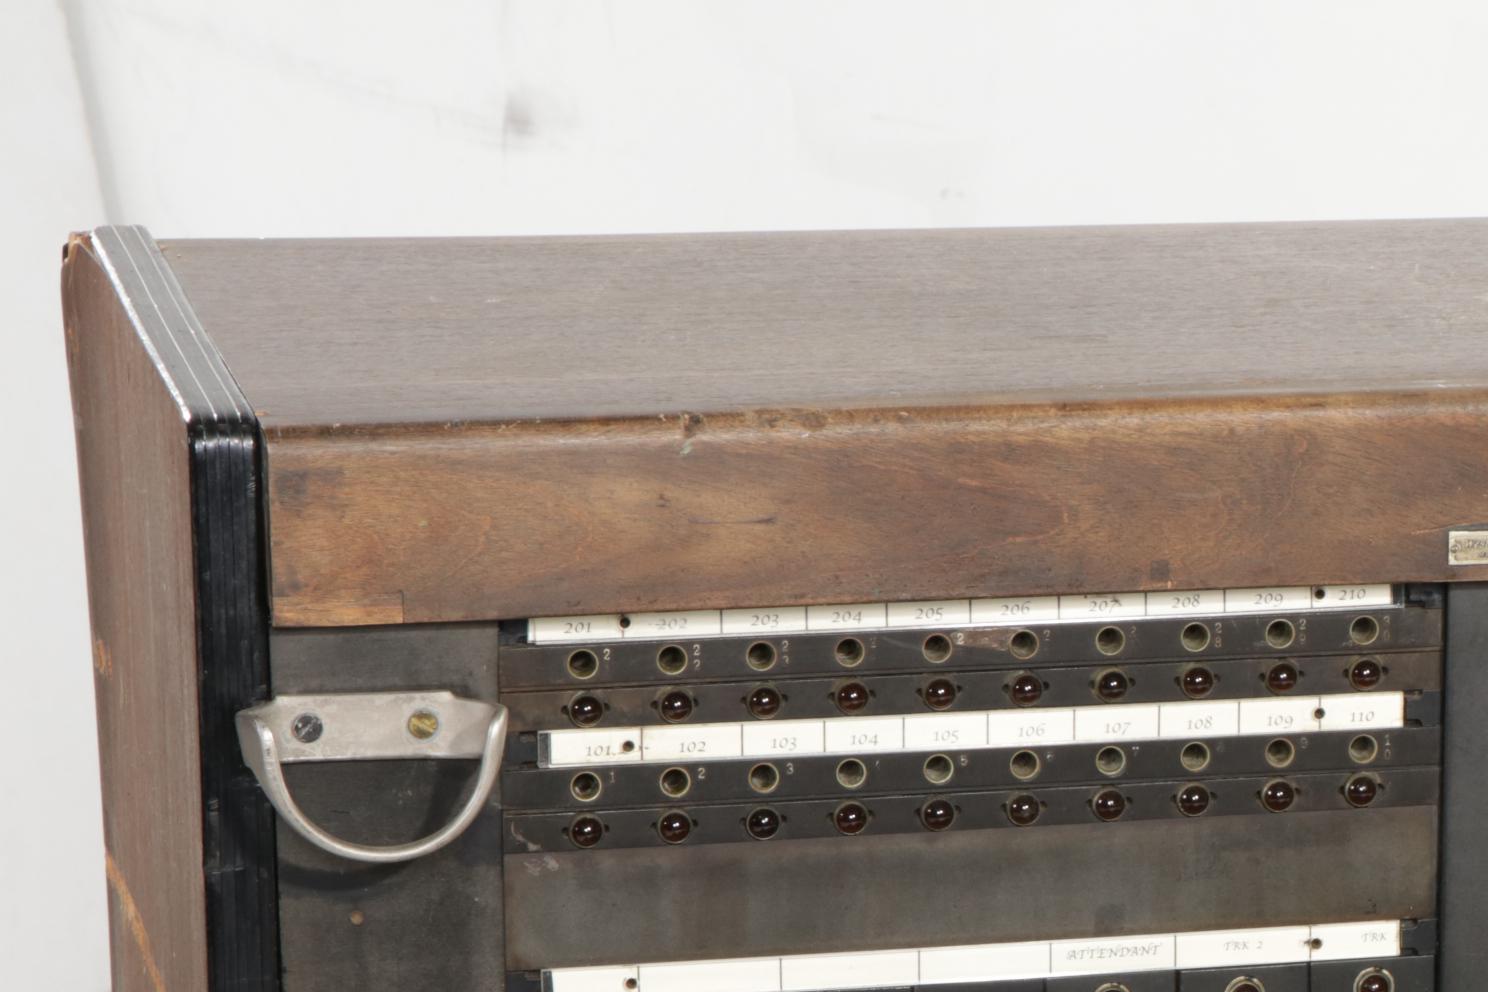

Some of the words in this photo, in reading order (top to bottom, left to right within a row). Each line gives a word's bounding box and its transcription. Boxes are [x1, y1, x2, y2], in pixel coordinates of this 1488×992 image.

[1171, 595, 1200, 609] 208
[1253, 592, 1283, 607] 209
[1338, 588, 1367, 601] 210
[1000, 600, 1032, 616] 206
[1088, 598, 1116, 613] 207
[750, 613, 780, 628] 203
[832, 610, 862, 625] 204
[914, 607, 945, 622] 205
[564, 620, 592, 634] 201
[654, 617, 687, 631] 202
[1186, 715, 1214, 731] 108
[1266, 714, 1294, 729] 109
[1349, 710, 1375, 723] 110
[932, 727, 960, 742] 105
[1017, 722, 1046, 738] 106
[1104, 720, 1131, 735] 107
[678, 739, 707, 754] 102
[771, 736, 798, 750] 103
[849, 732, 879, 747] 104
[585, 743, 612, 757] 101
[1223, 940, 1249, 951] TRK
[1256, 940, 1264, 950] 2
[1361, 932, 1387, 944] TRK
[1066, 942, 1162, 961] ATTENDANT
